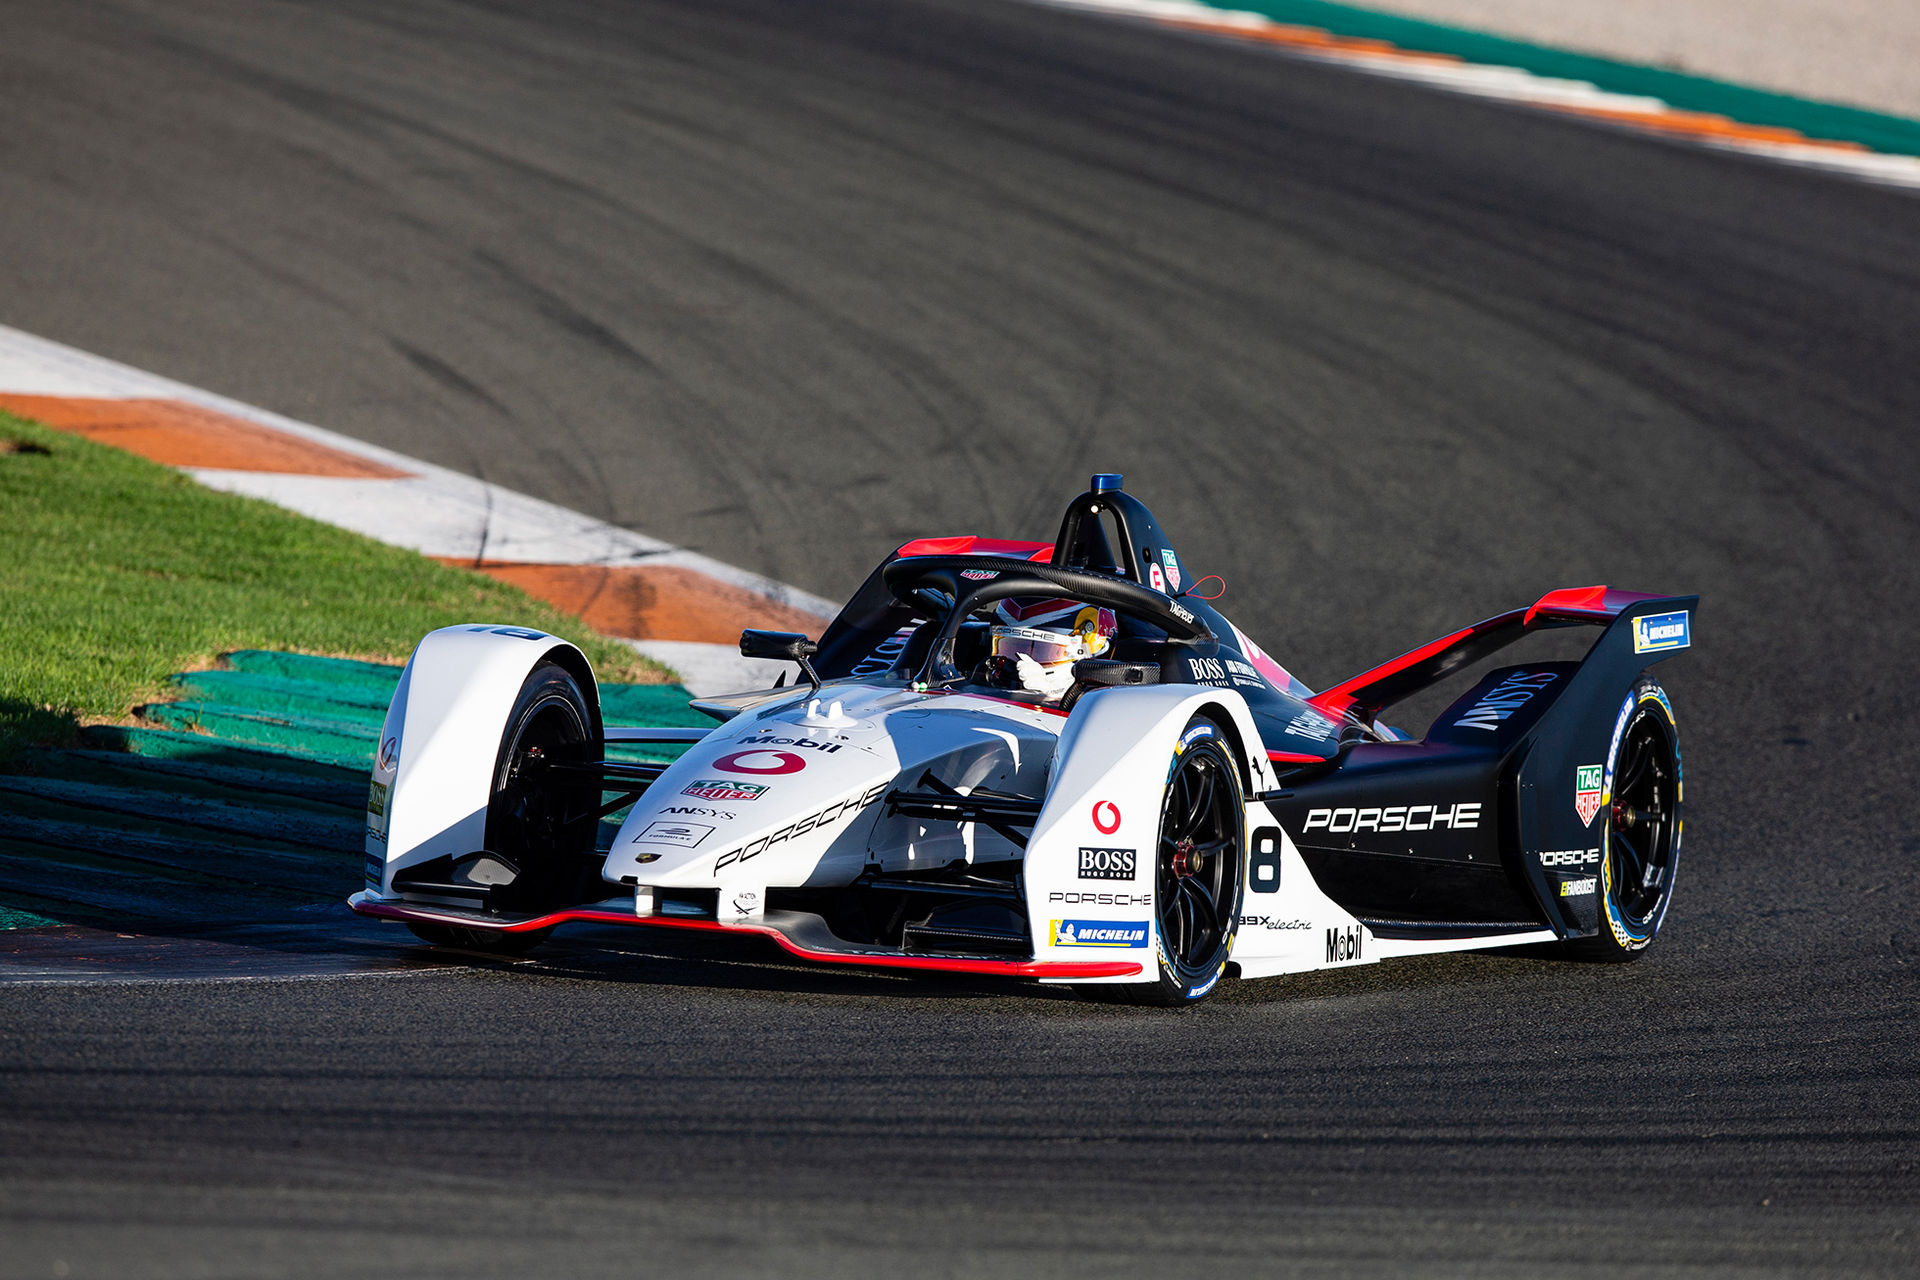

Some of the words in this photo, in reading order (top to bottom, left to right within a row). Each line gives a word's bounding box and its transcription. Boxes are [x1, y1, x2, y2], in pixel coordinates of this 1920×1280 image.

[1188, 657, 1225, 680] BOSS
[1453, 671, 1558, 731] ANSYS
[736, 735, 843, 754] Mobil
[700, 781, 759, 791] TAG
[1579, 768, 1600, 789] TAG
[686, 787, 757, 800] HEUER
[658, 807, 737, 820] ANSYS
[1302, 802, 1482, 834] PORSCHE
[713, 781, 890, 877] PORSCHE
[1080, 849, 1134, 871] BOSS
[1250, 826, 1282, 893] 8
[1049, 892, 1152, 905] PORSCHE
[1077, 928, 1145, 940] MICHELIN
[1266, 919, 1312, 930] electric
[1326, 924, 1363, 963] Mobil
